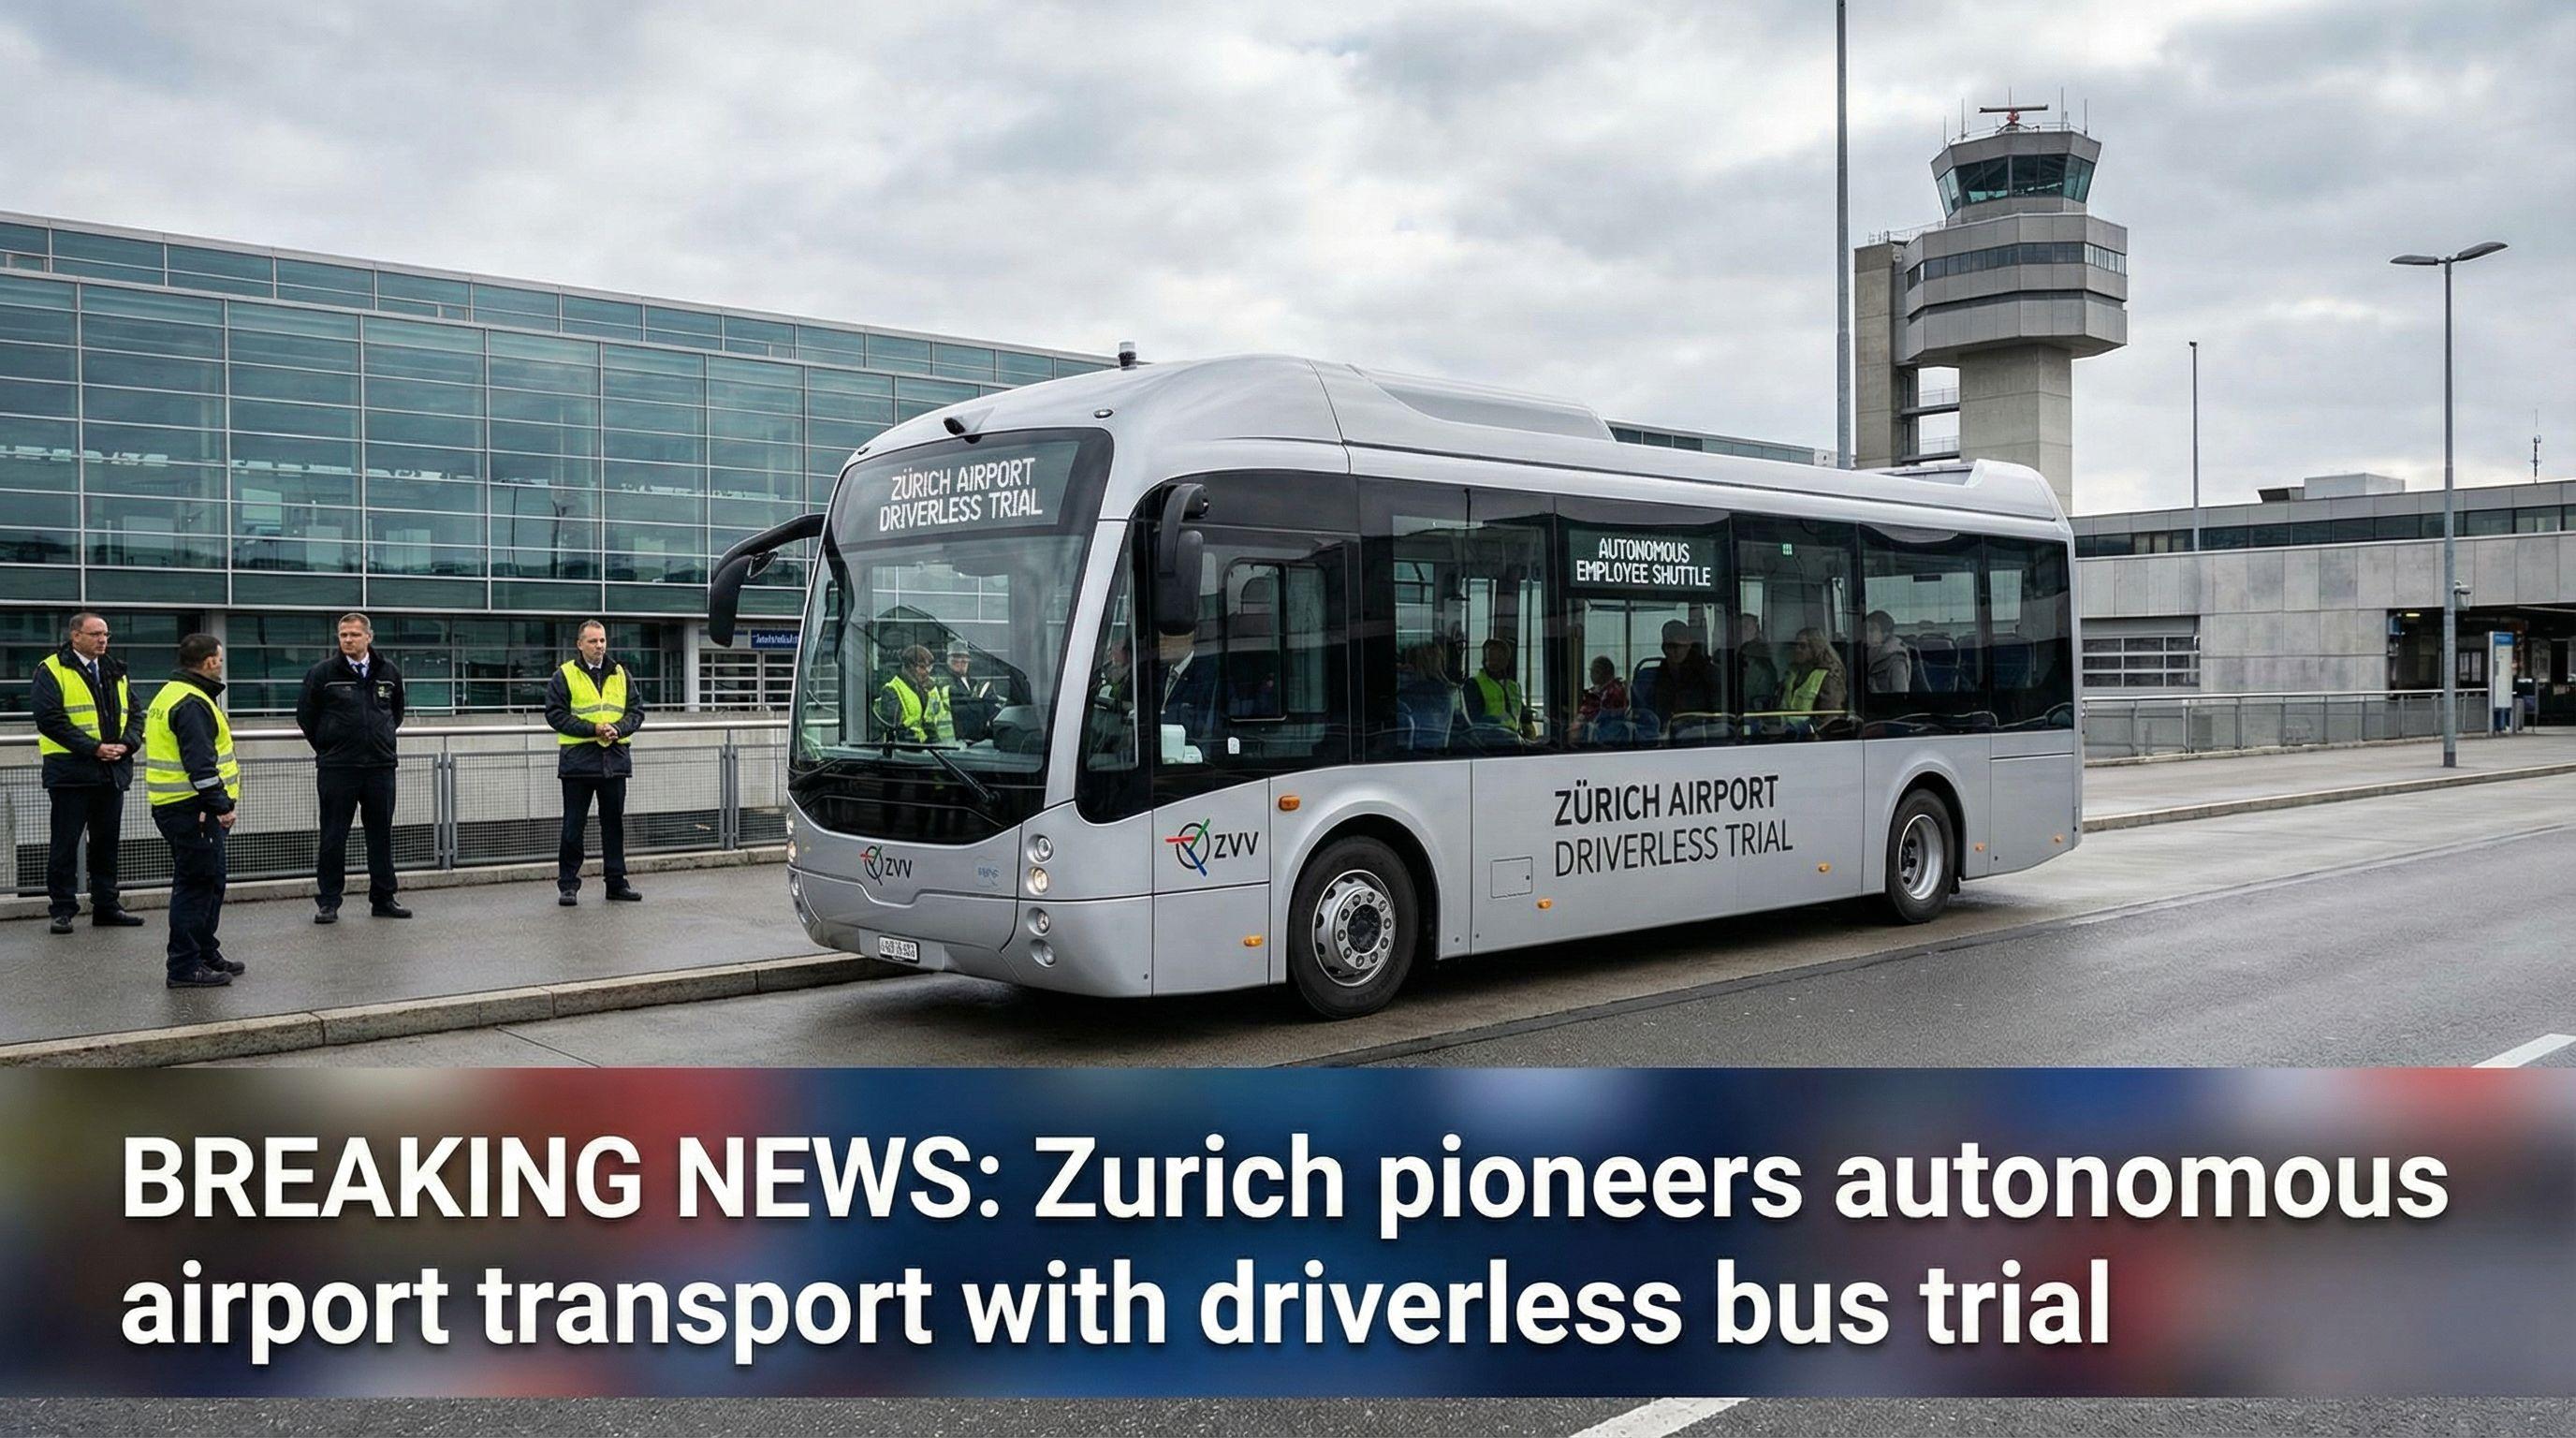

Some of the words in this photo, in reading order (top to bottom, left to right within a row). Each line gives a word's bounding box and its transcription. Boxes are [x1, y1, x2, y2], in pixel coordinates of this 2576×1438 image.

[891, 468, 951, 501] ZÜRICH
[957, 458, 1036, 492] AIRPORT
[879, 494, 983, 532] DRIVERLESS
[988, 488, 1043, 519] TRIAL
[1599, 537, 1690, 564] AUTONOMOUS
[1576, 560, 1648, 584] EMPLOYEE
[1652, 564, 1711, 586] SHUTTLE
[1554, 779, 1661, 826] ZÜRICH
[1668, 774, 1778, 817] AIRPORT
[1214, 831, 1259, 858] ZVV
[1556, 826, 1719, 877] DRIVERLESS
[1725, 819, 1793, 858] TRIAL
[886, 858, 913, 879] ZVV
